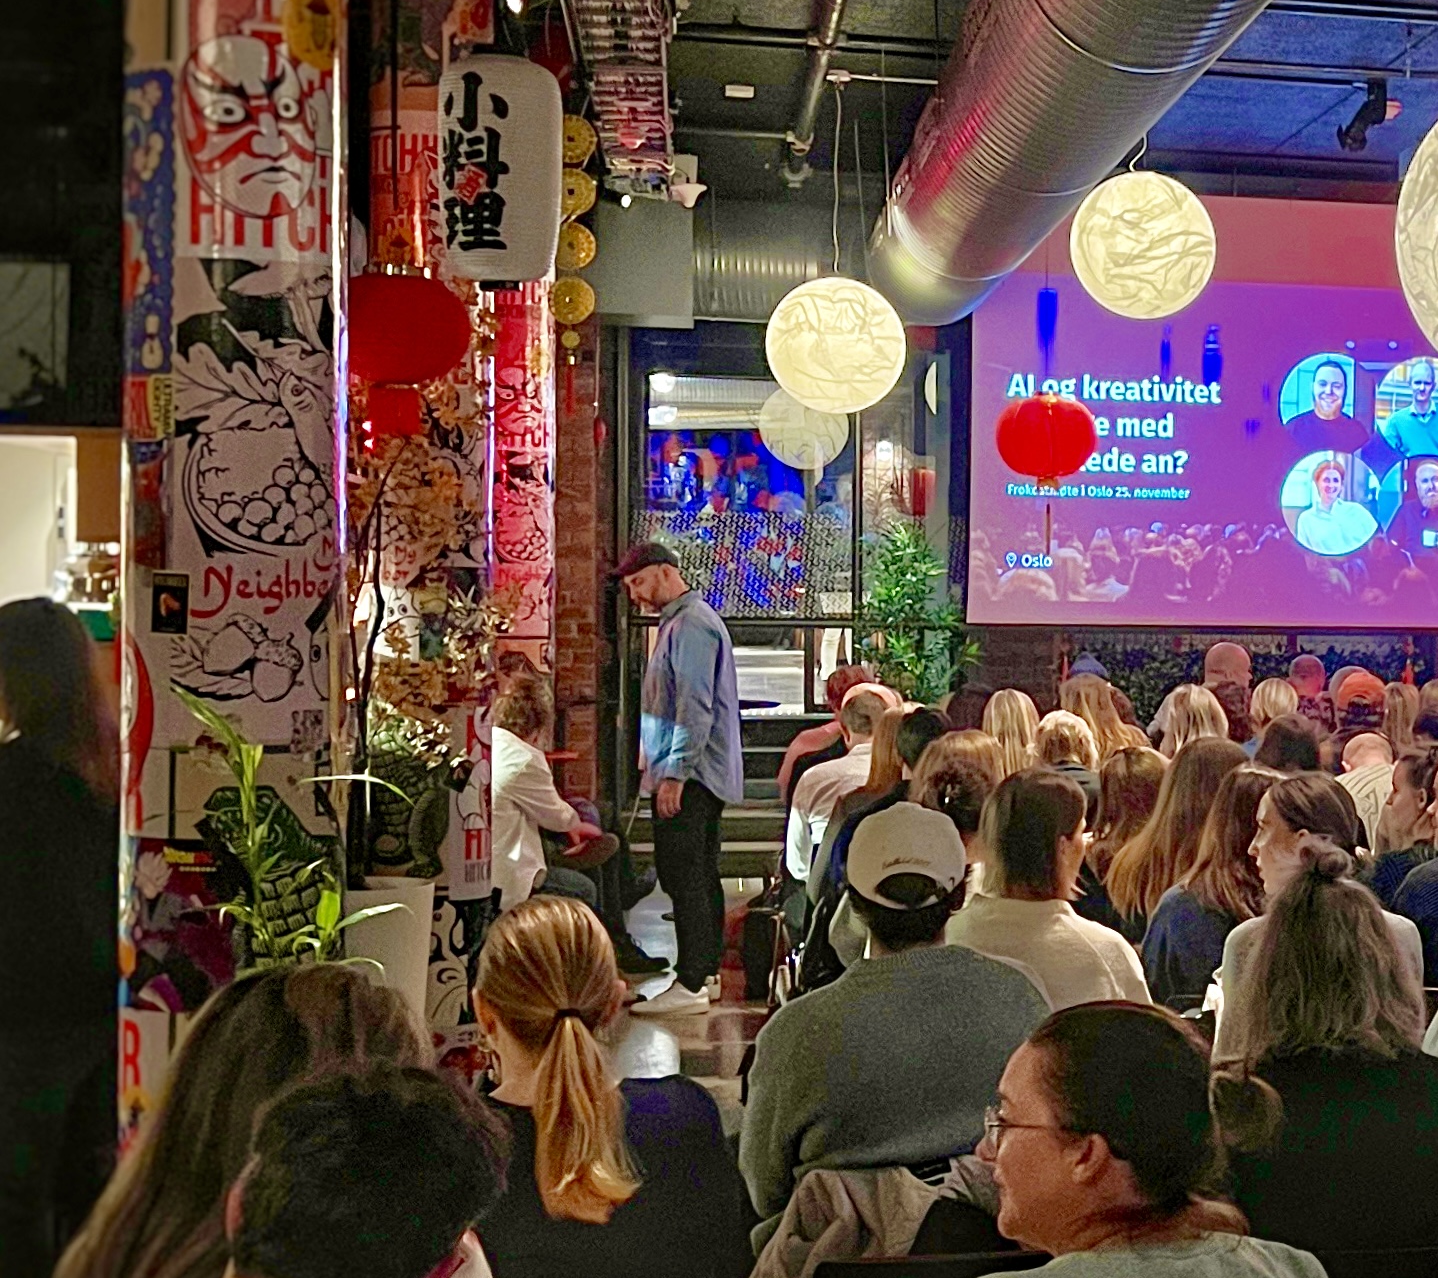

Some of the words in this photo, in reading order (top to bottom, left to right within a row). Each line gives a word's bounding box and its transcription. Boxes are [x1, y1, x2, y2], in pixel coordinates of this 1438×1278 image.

[443, 70, 511, 253] 小料理
[1007, 373, 1034, 398] AI
[1082, 374, 1222, 404] kreativitet
[1116, 412, 1174, 438] med
[1141, 450, 1189, 473] an?
[1080, 484, 1086, 497] i
[1087, 485, 1113, 498] Oslo
[1115, 486, 1131, 498] 25.
[1133, 487, 1191, 499] november
[1021, 553, 1053, 568] Oslo
